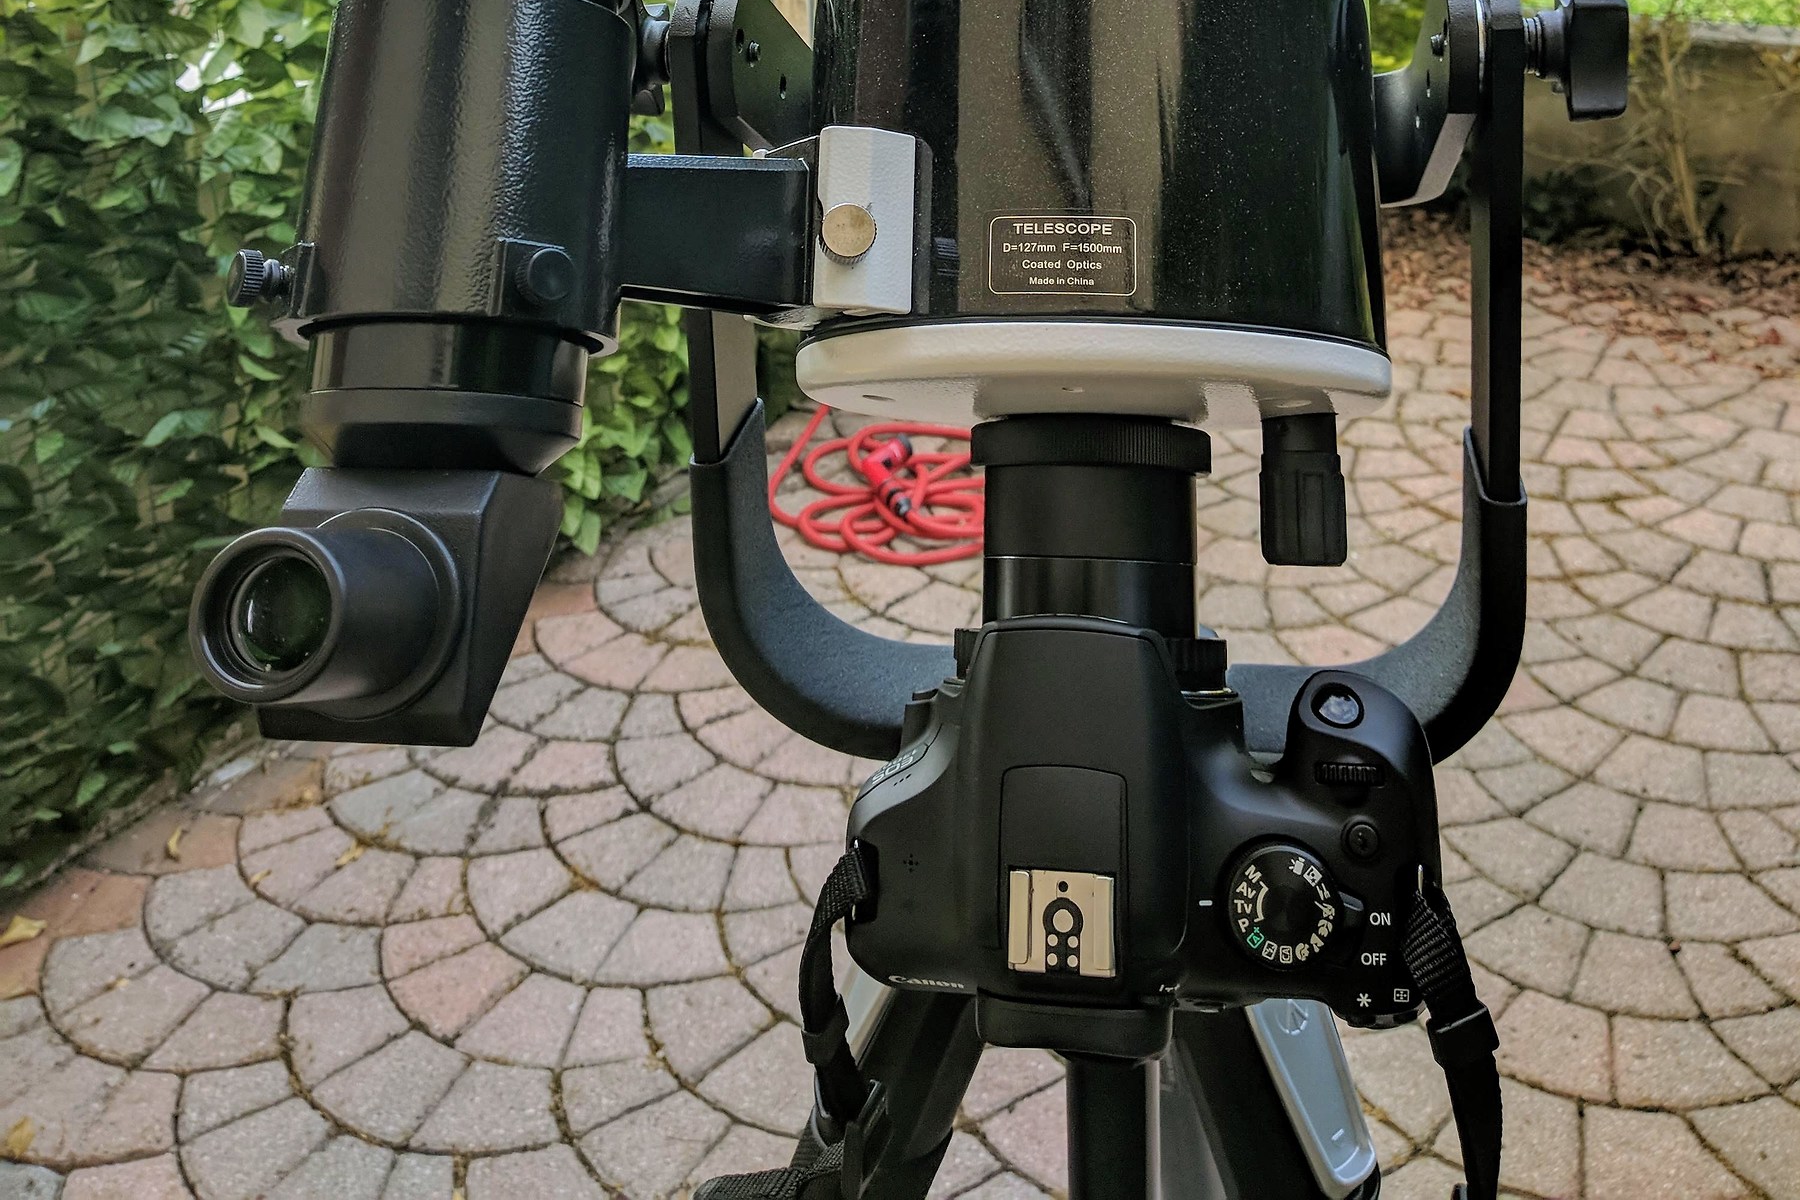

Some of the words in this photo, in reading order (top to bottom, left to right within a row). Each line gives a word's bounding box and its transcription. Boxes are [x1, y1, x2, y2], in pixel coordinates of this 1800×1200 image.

[1012, 222, 1113, 235] TELESCOPE
[1002, 242, 1056, 253] D=127mm
[1062, 242, 1123, 254] F=1500mm
[1021, 259, 1061, 269] Coated
[1066, 260, 1102, 271] Optics
[1029, 277, 1055, 285] Made
[1056, 277, 1065, 285] in
[1066, 277, 1095, 286] China
[1244, 864, 1262, 884] M
[1235, 881, 1256, 899] Av
[1233, 899, 1252, 914] Tv
[1238, 918, 1249, 933] P
[1369, 912, 1391, 926] ON
[1361, 952, 1387, 966] OFF
[888, 975, 964, 989] Canon
